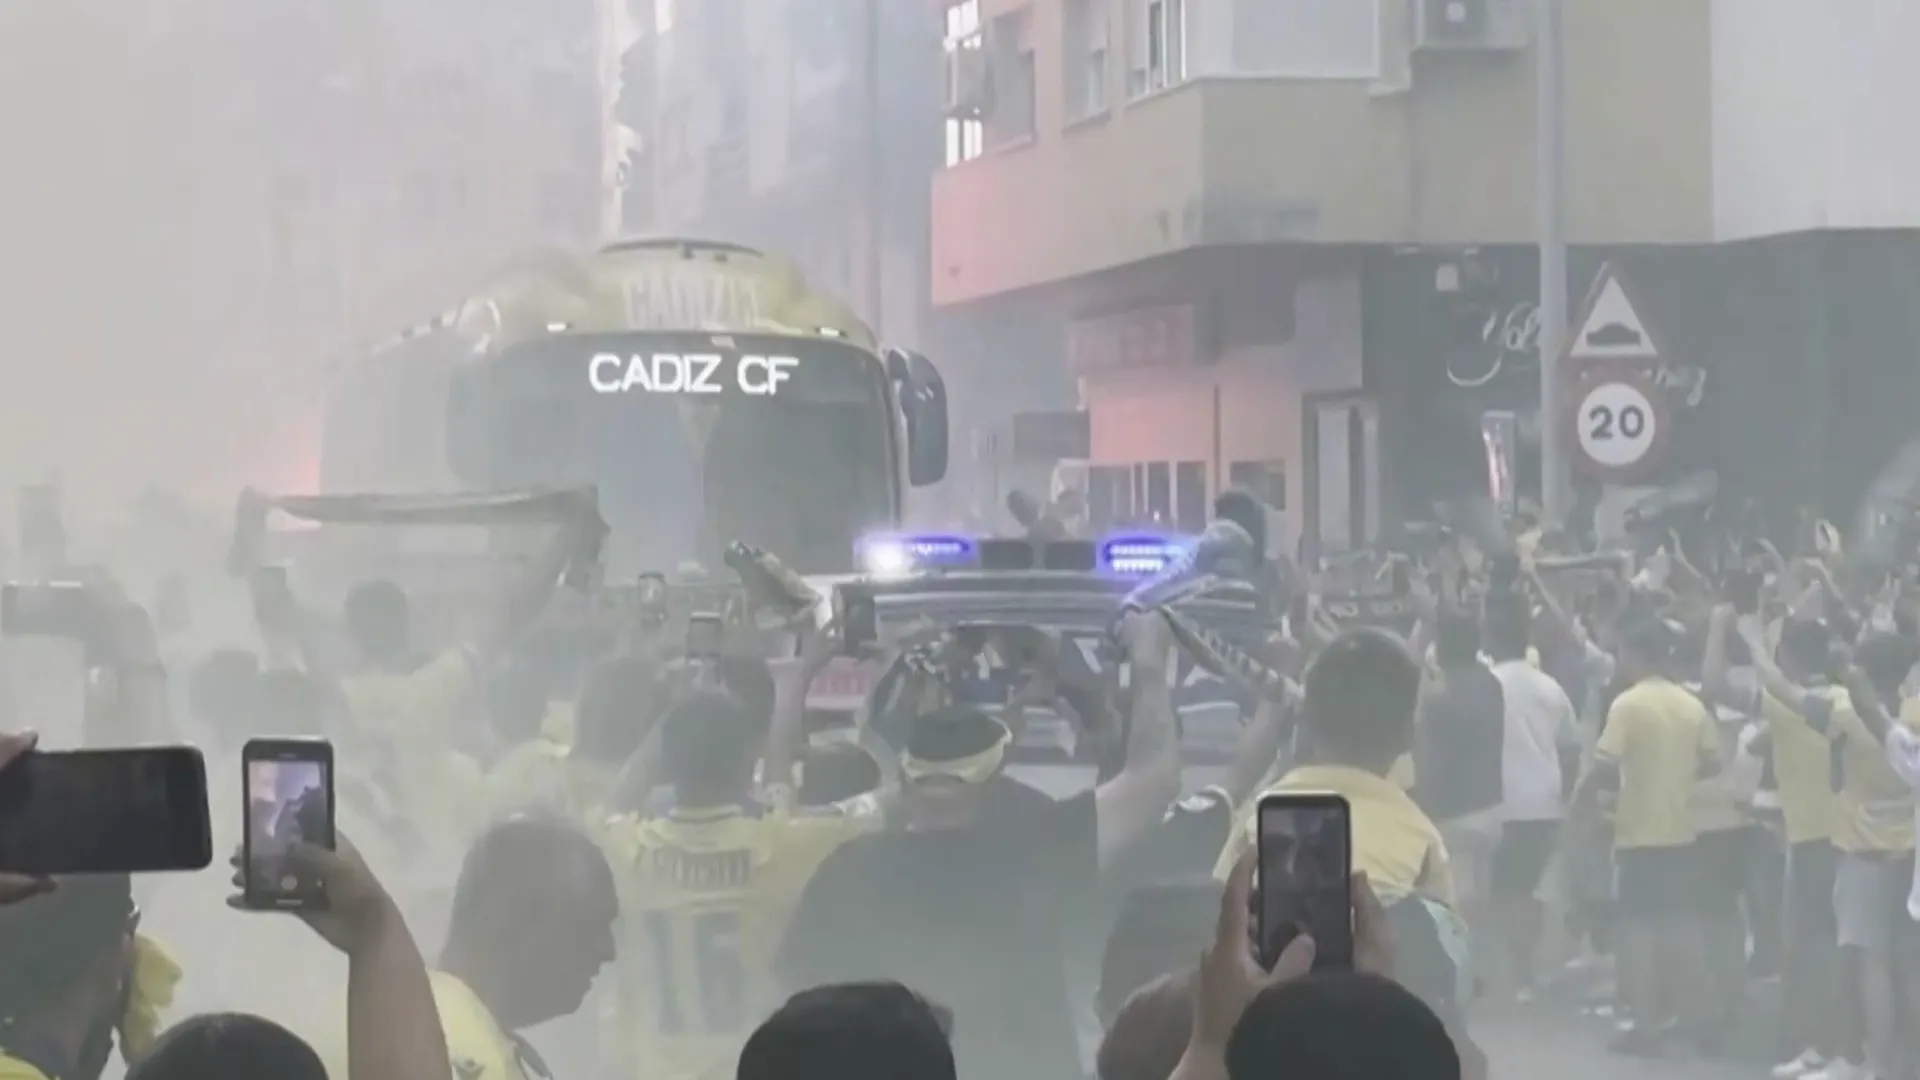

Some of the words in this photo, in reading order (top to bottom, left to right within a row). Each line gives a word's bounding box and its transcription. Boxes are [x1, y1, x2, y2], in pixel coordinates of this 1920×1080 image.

[588, 353, 722, 393] CADIZ
[737, 354, 800, 395] CF
[1587, 403, 1645, 441] 20
